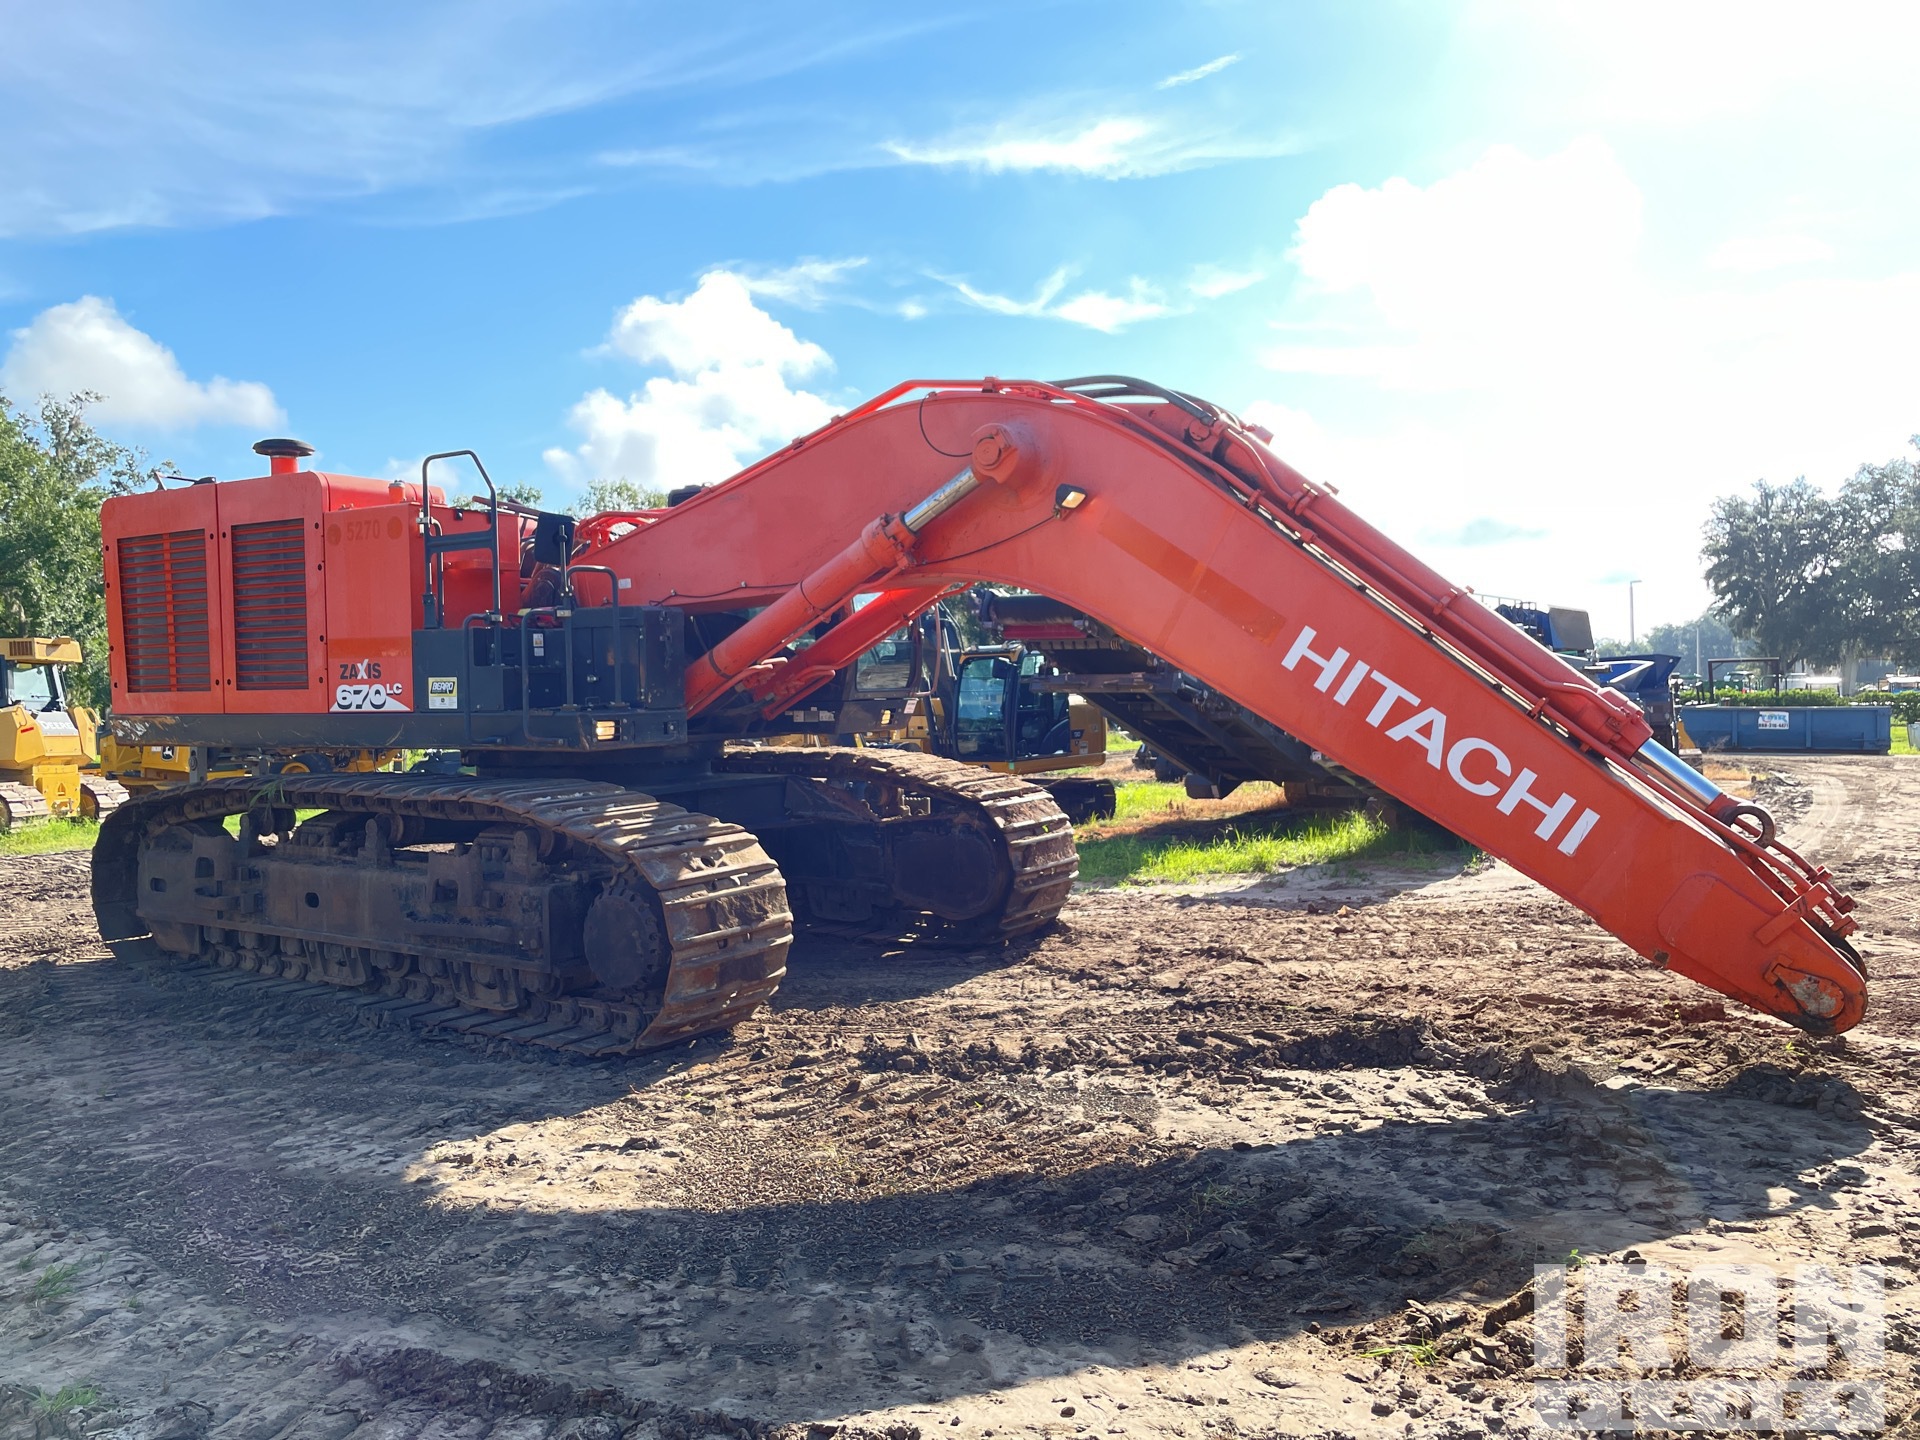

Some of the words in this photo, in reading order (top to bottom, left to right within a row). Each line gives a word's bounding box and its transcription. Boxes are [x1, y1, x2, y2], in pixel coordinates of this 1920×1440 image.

[346, 519, 380, 541] 5270
[340, 659, 381, 680] ZAXIS
[40, 721, 75, 730] DEERE
[1281, 625, 1601, 857] HITACHI
